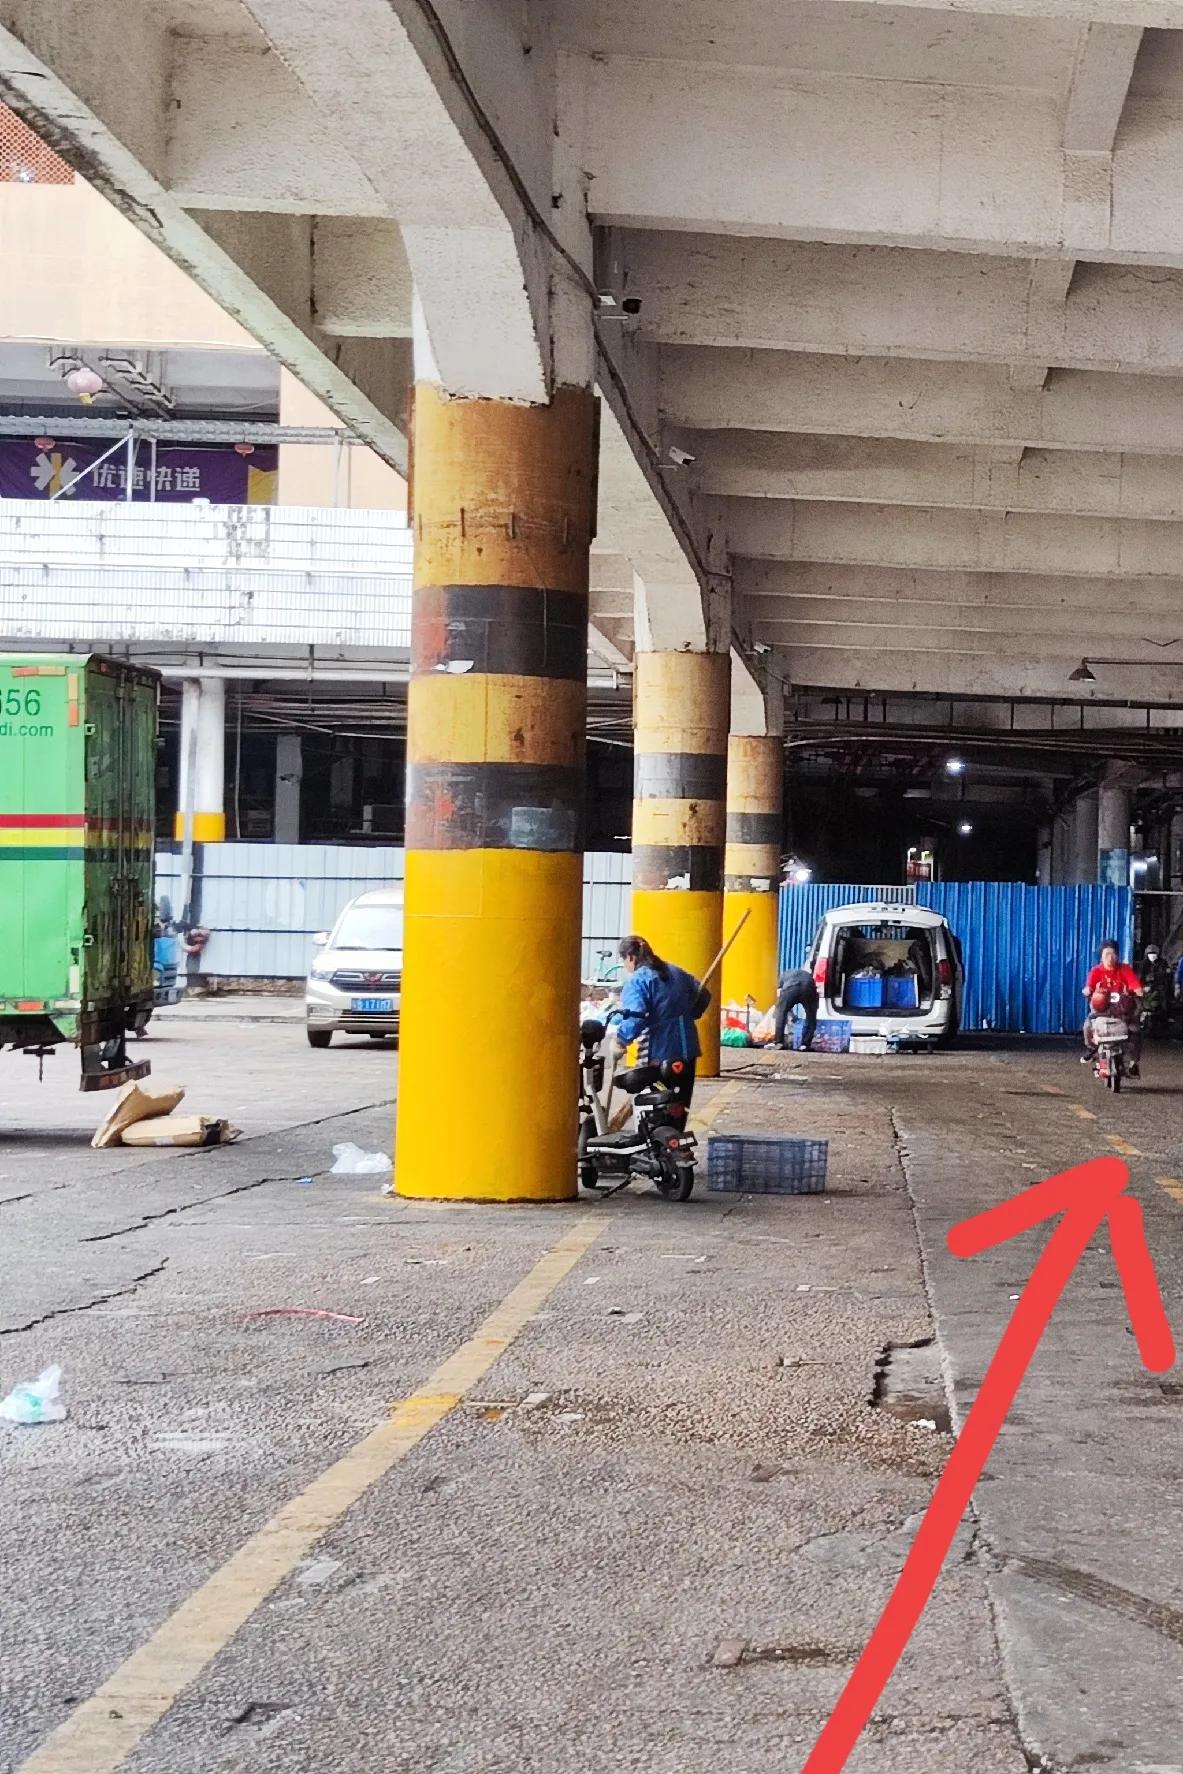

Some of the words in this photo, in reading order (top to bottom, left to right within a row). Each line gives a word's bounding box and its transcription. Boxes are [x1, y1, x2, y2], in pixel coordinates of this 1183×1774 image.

[93, 464, 201, 492] 优速快递
[0, 689, 41, 716] 56
